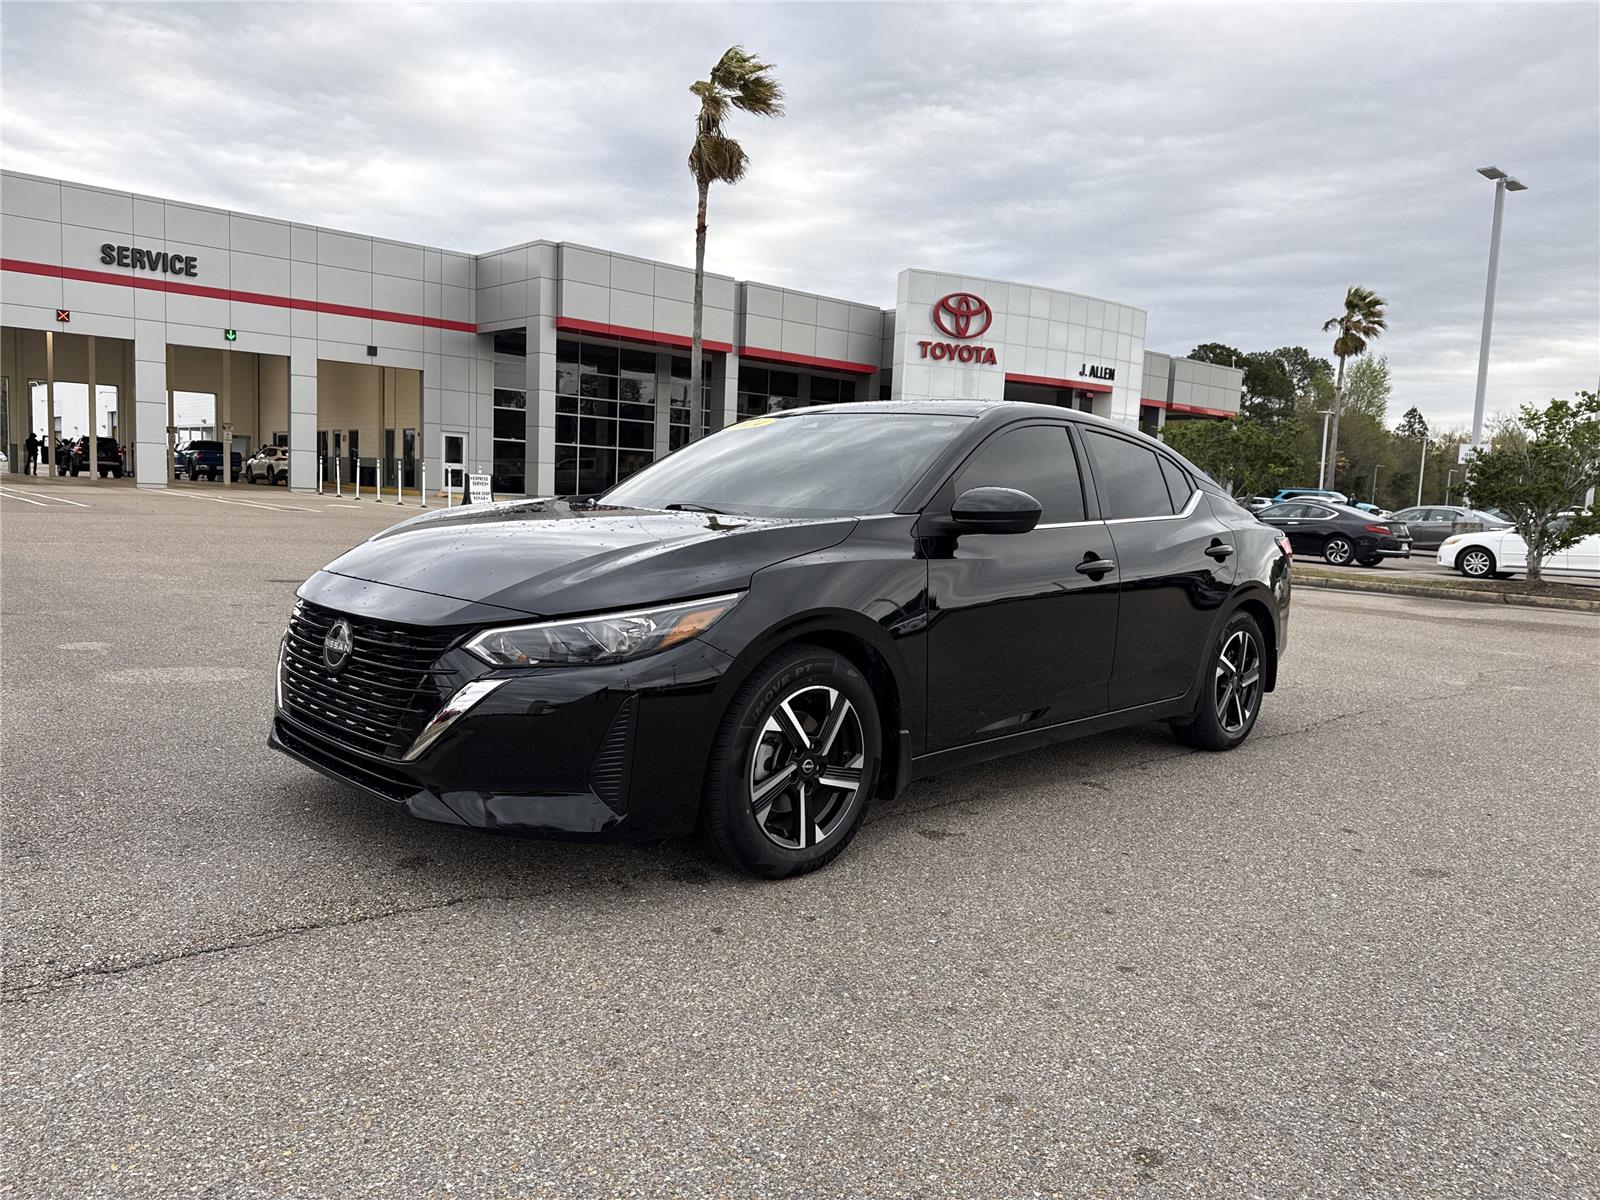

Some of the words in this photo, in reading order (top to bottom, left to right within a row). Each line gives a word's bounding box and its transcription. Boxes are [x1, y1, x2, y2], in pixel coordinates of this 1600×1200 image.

[100, 243, 199, 277] SERVICE
[918, 341, 998, 365] TOYOTA
[1079, 363, 1088, 377] J.
[1089, 365, 1116, 381] ALLEN
[325, 639, 352, 655] SSAN
